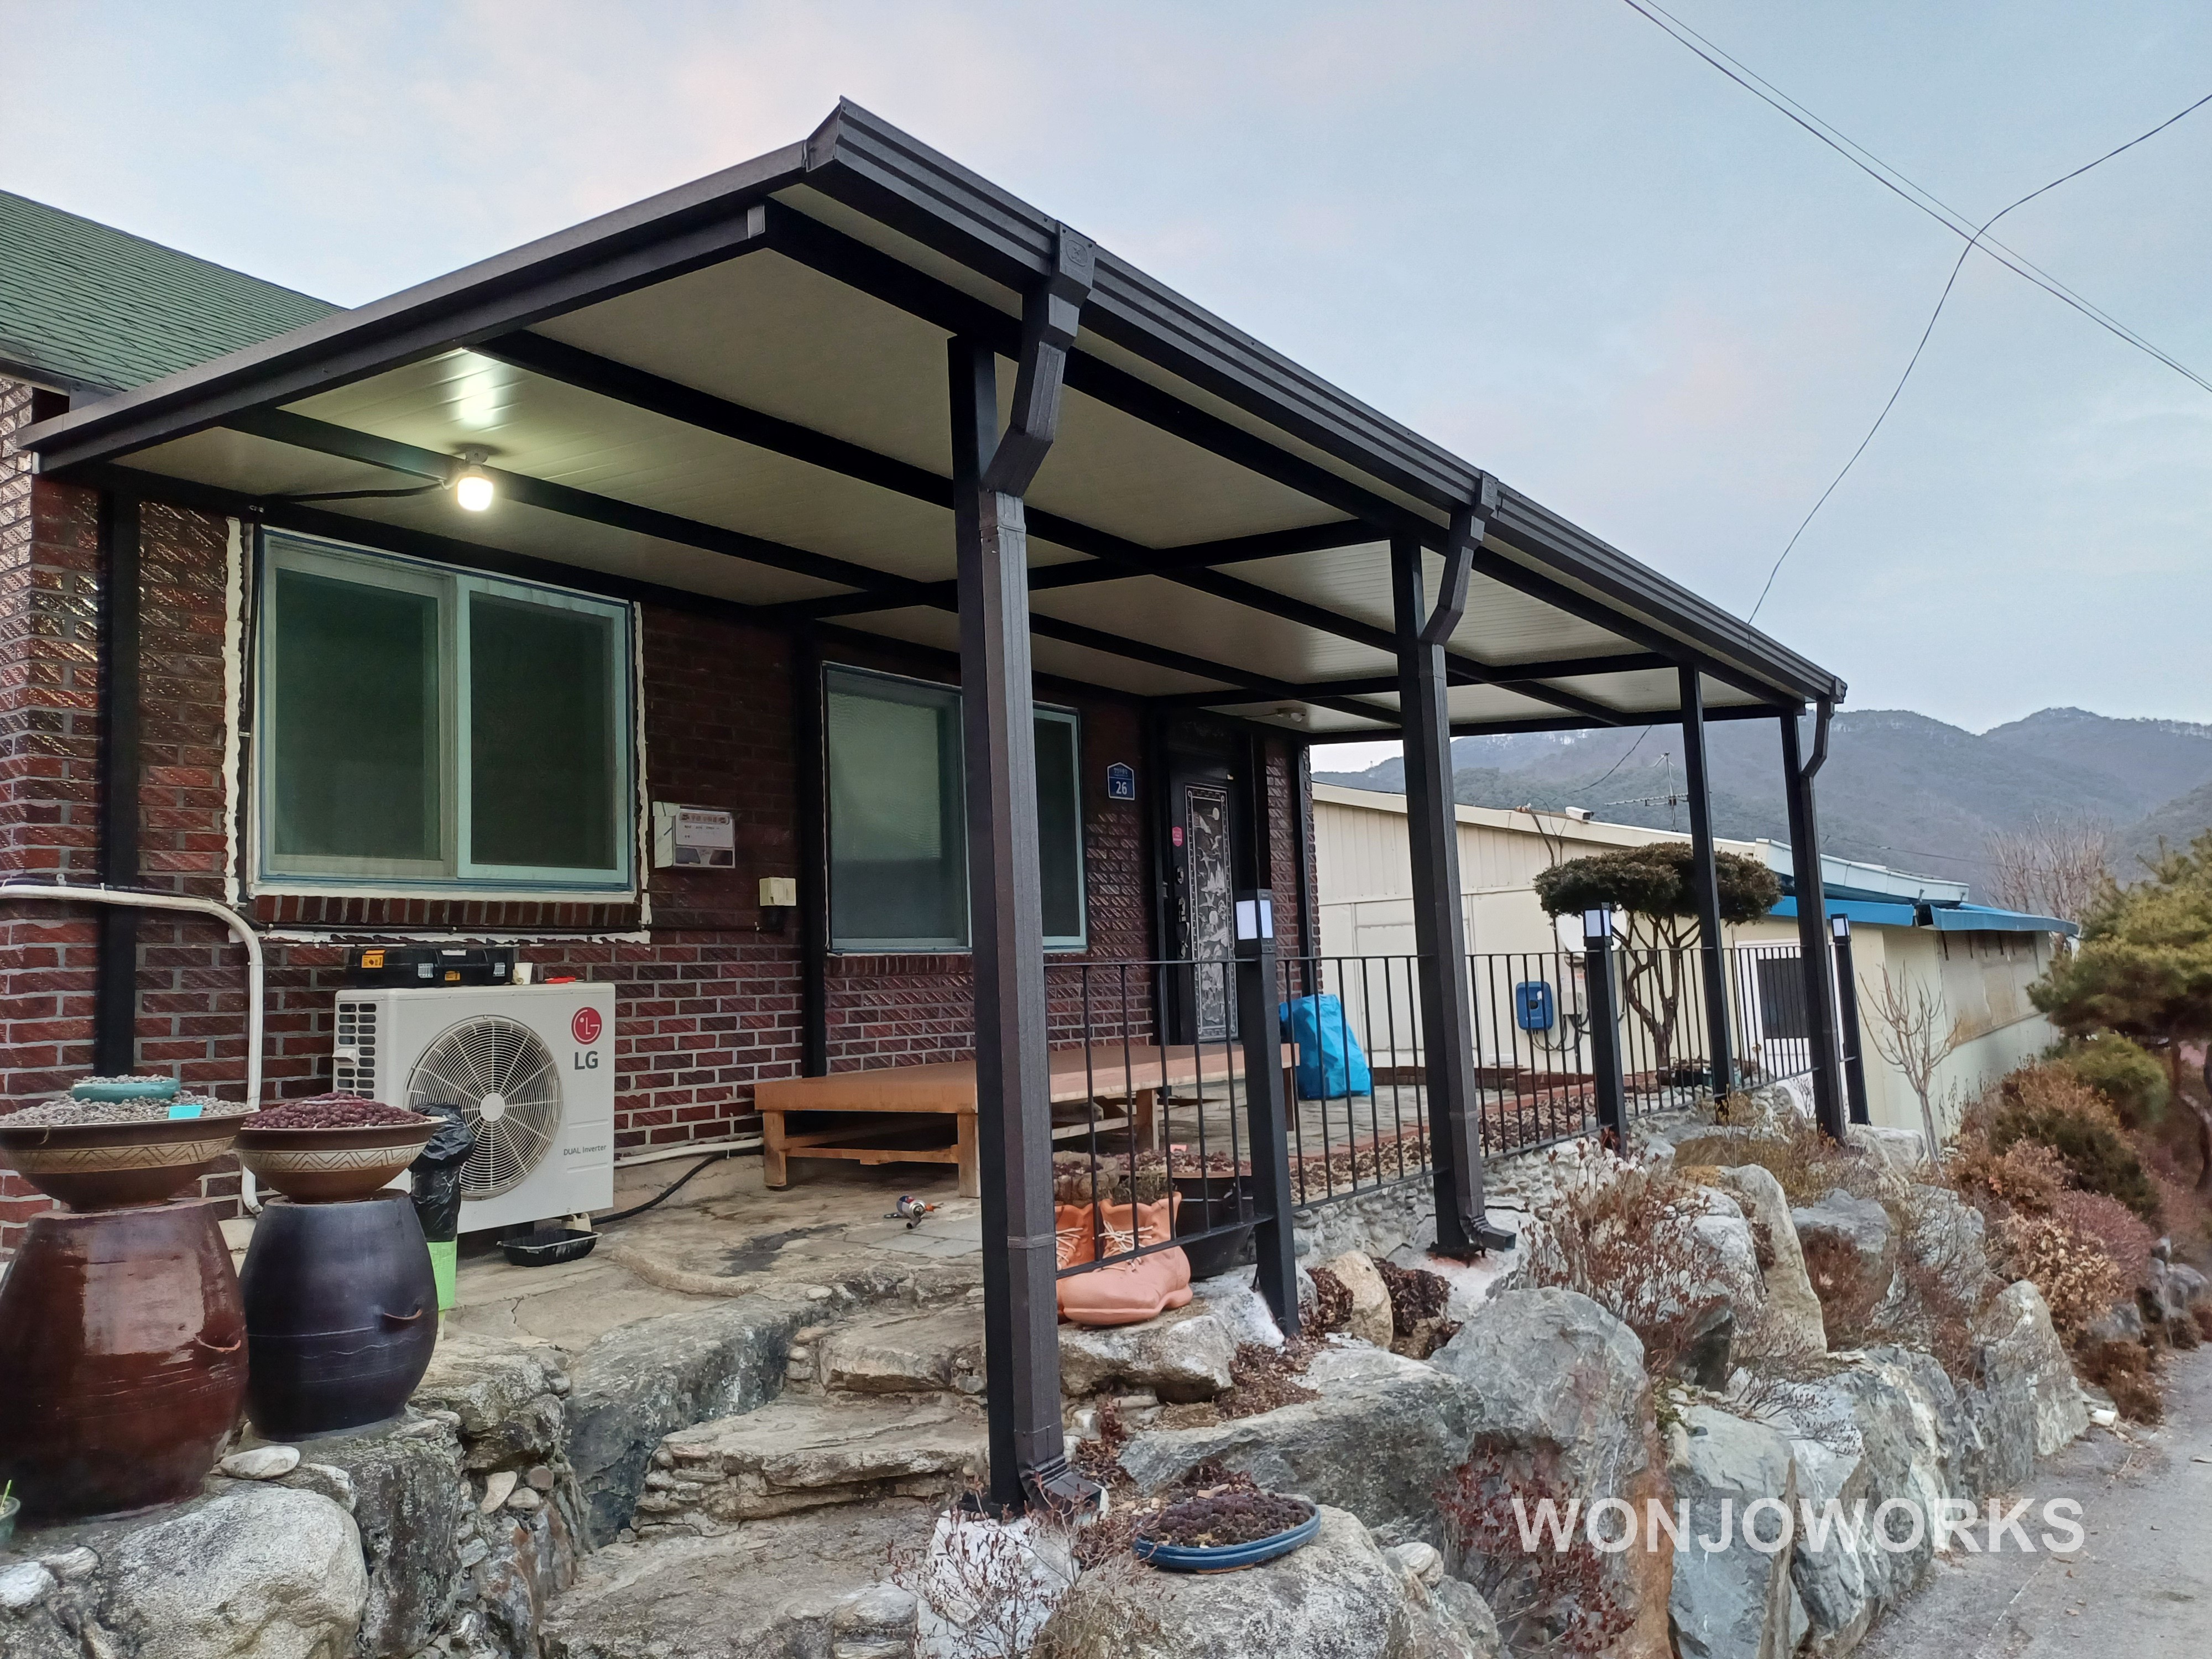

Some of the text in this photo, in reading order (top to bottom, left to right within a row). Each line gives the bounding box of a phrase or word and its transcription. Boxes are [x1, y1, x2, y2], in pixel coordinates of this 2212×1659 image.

[1115, 781, 1127, 795] 26
[575, 1051, 598, 1070] LG
[582, 1145, 607, 1153] Inverter
